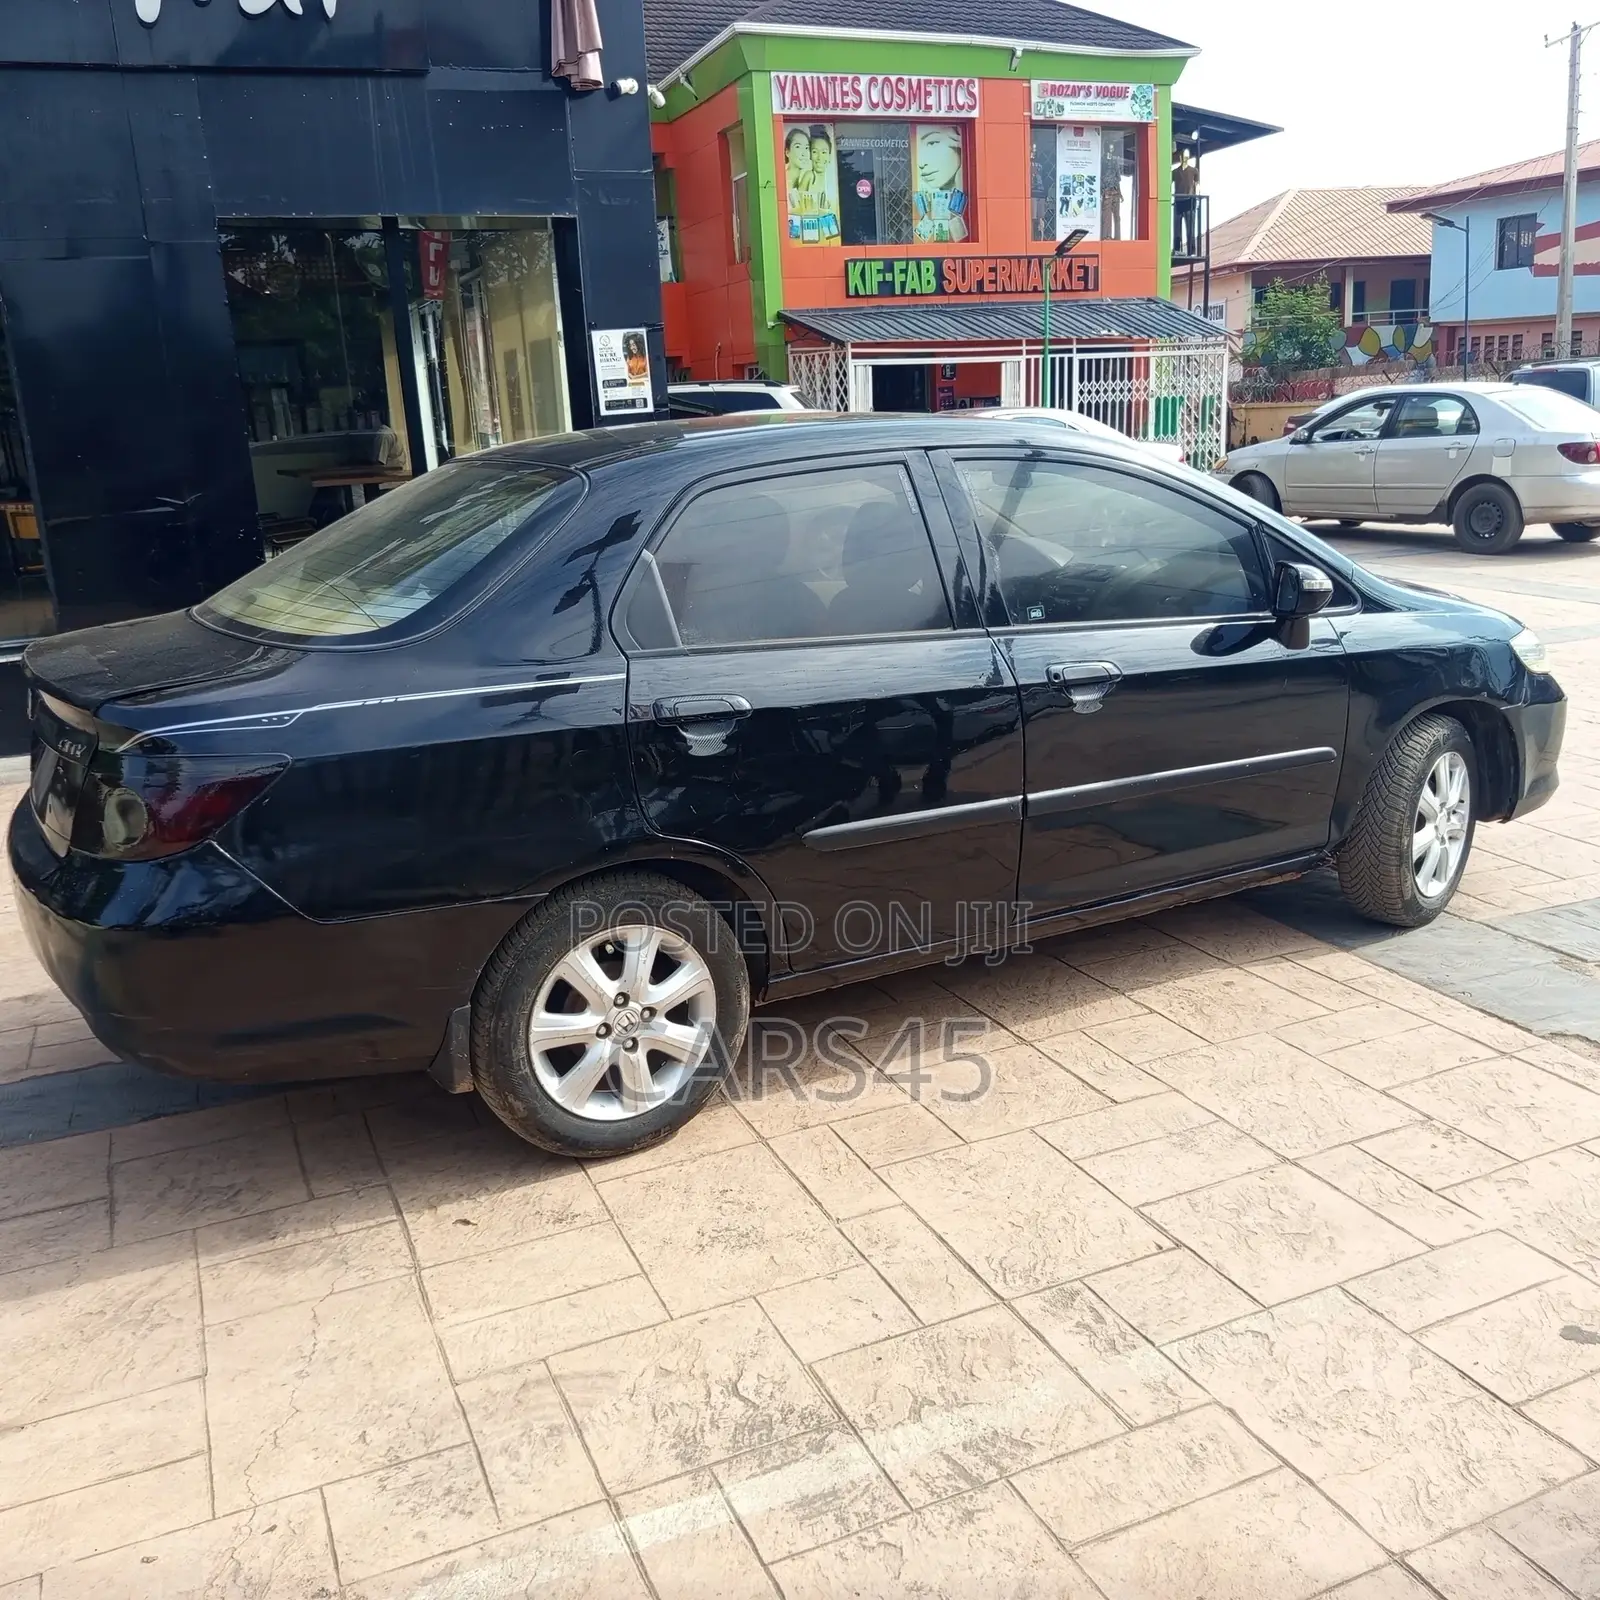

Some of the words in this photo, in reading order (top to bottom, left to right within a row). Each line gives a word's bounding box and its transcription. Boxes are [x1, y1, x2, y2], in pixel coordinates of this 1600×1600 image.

[774, 74, 863, 111] YANNIES
[867, 76, 978, 113] COSMETICS
[1050, 84, 1092, 98] ROZAY'S
[1095, 85, 1130, 99] VOGUE
[840, 138, 870, 147] YANNIES
[870, 139, 909, 148] COSMETICS
[847, 259, 937, 296] KIF-FAB
[942, 257, 1100, 293] SUPERMARKET
